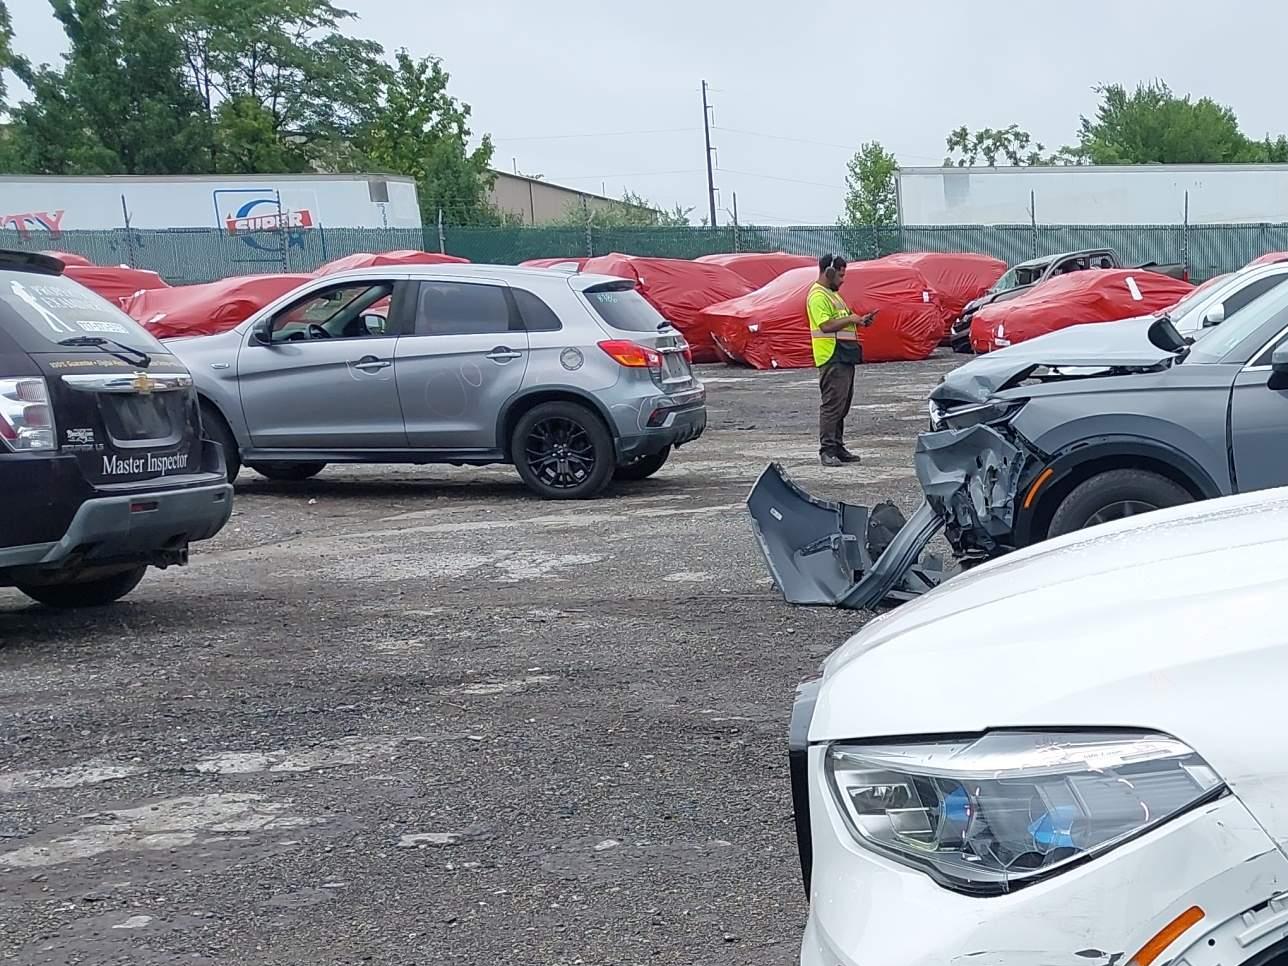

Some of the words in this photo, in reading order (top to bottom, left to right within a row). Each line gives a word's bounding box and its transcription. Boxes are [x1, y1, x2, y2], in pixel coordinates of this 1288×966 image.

[0, 210, 64, 240] TY
[102, 455, 144, 475] Master
[147, 453, 188, 476] Inspector
